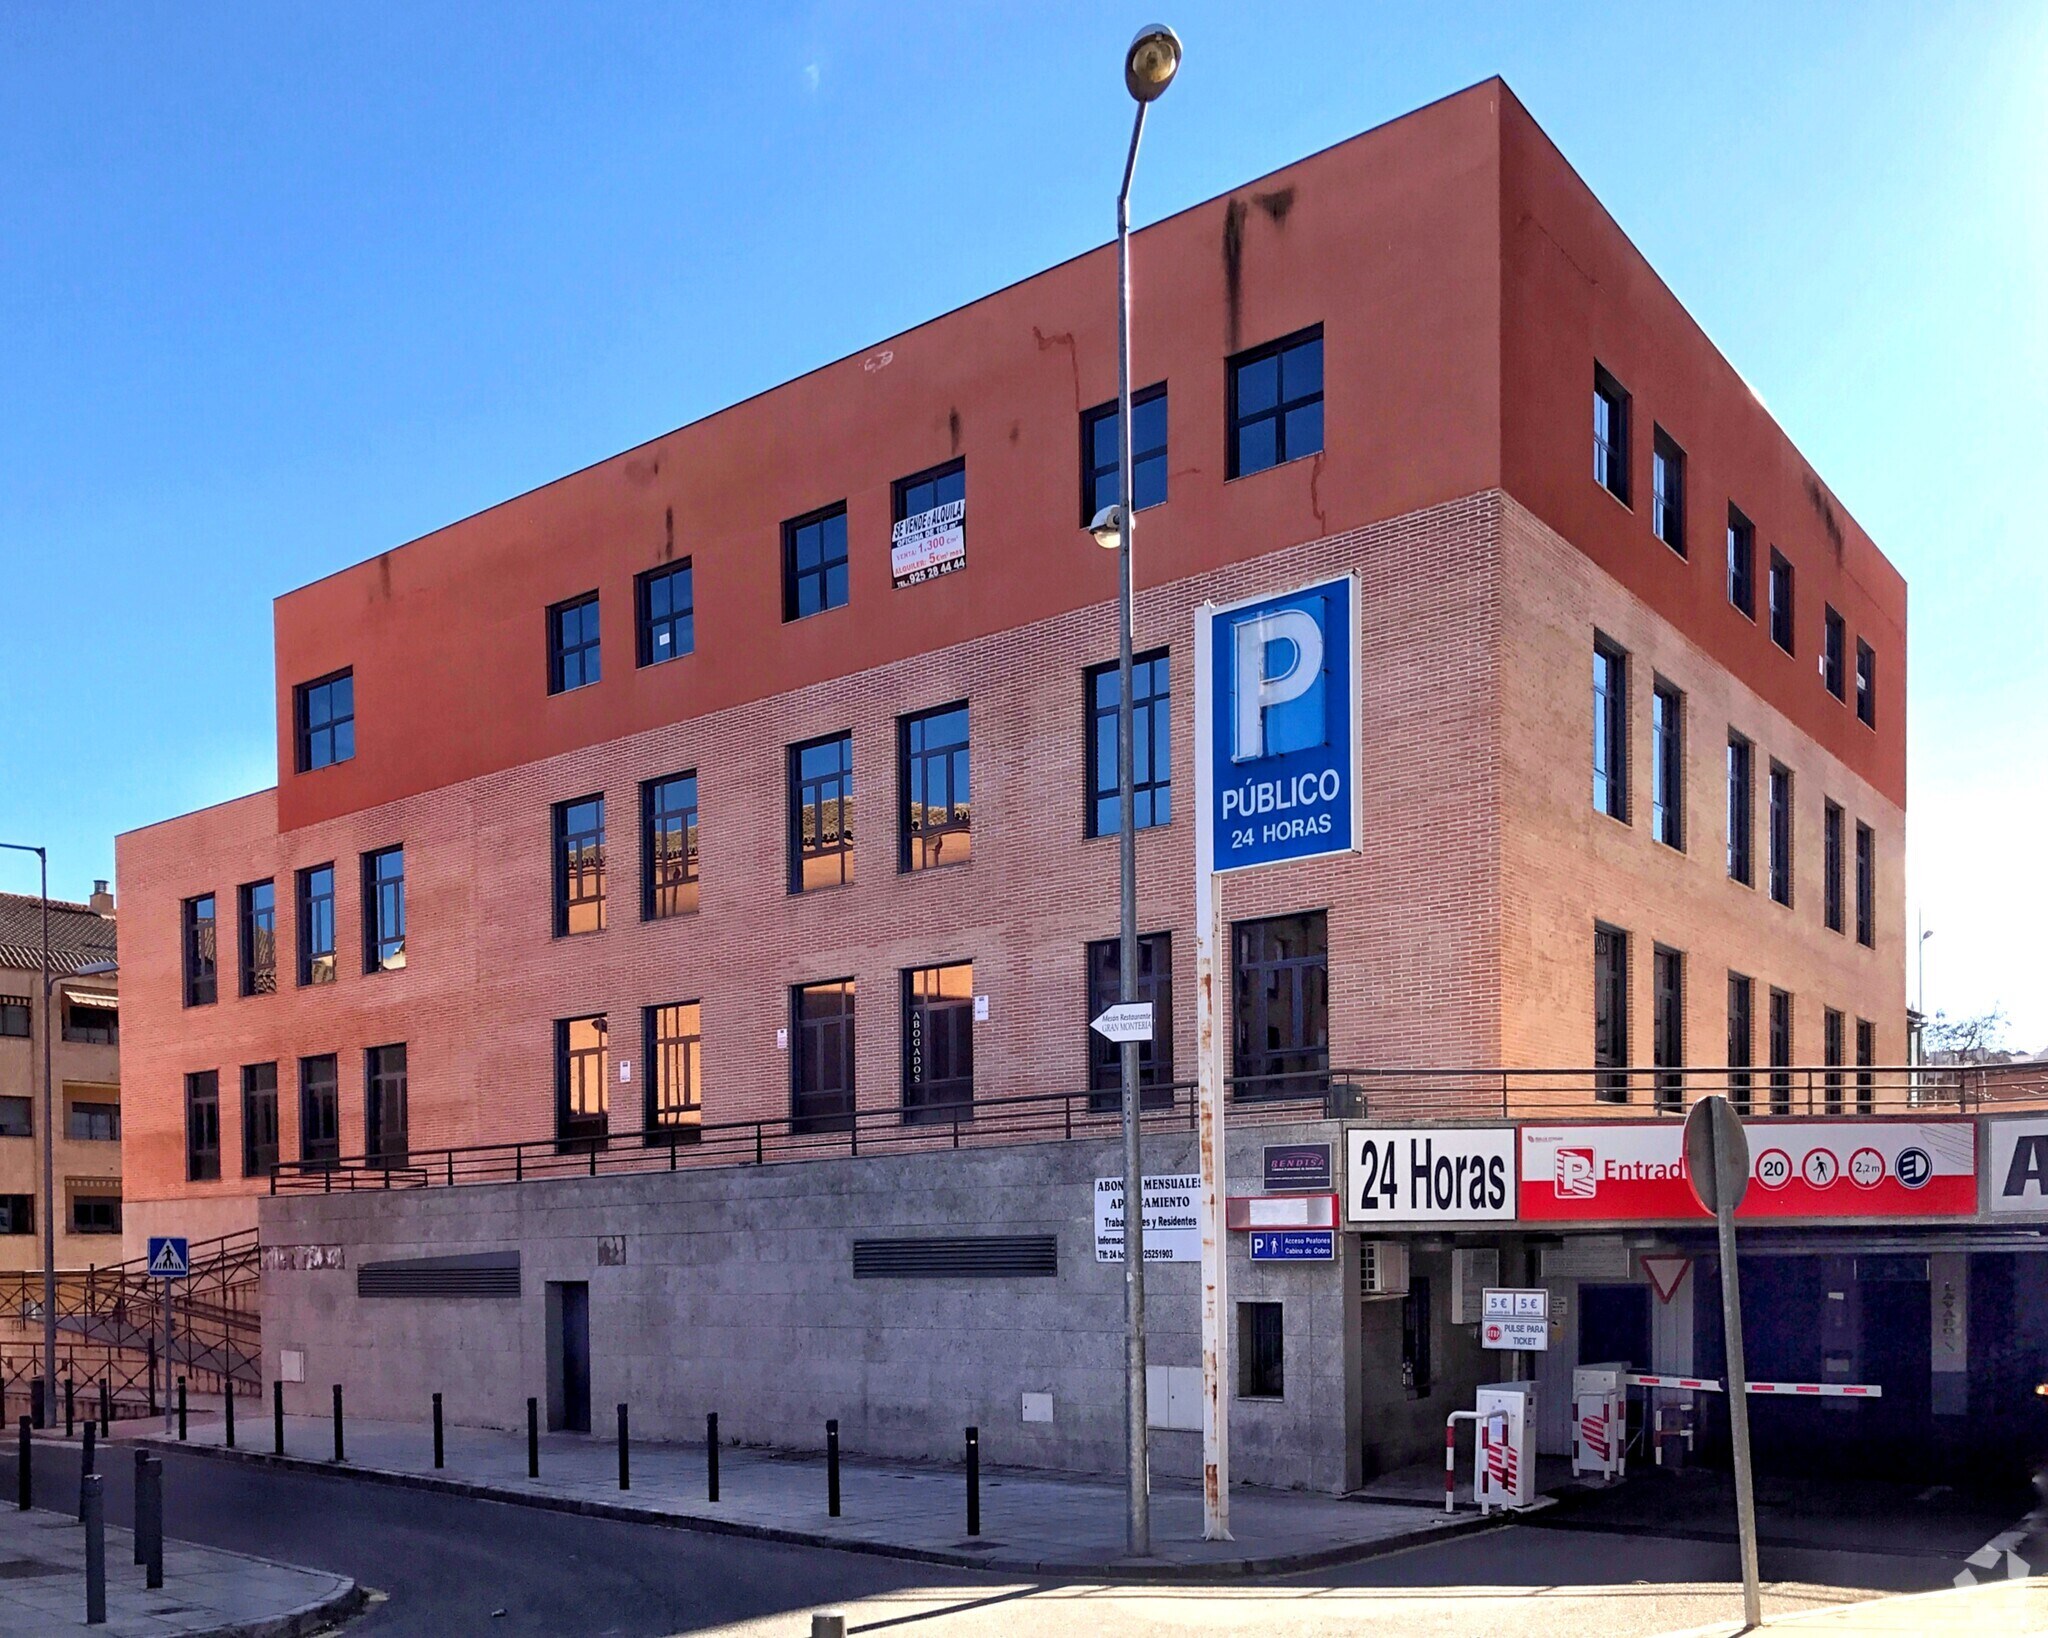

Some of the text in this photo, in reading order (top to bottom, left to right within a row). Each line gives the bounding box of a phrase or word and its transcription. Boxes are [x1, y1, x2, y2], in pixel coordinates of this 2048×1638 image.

[895, 522, 904, 539] SE
[905, 513, 927, 535] VENDE
[931, 501, 962, 525] ALQUILA
[896, 532, 924, 546] OFICINA
[925, 529, 934, 538] DE
[918, 536, 945, 553] 1.300
[929, 552, 936, 564] 5
[909, 569, 926, 584] 925
[927, 566, 939, 578] 28
[940, 561, 952, 574] 44
[953, 556, 966, 569] 44
[1233, 608, 1323, 763] P
[1222, 767, 1341, 820] PÚBLICO
[1231, 812, 1333, 849] 24 HORAS
[912, 1011, 921, 1083] ABOGADOS
[1360, 1137, 1506, 1211] 24 Horas
[1603, 1157, 1684, 1180] Entrad
[1763, 1161, 1784, 1177] 20
[1152, 1219, 1157, 1230] y
[1158, 1215, 1197, 1227] Residentes
[1254, 1238, 1264, 1254] P
[1313, 1246, 1331, 1254] Cobro
[1491, 1298, 1507, 1308] 5 €
[1521, 1299, 1537, 1308] 5 €
[1487, 1330, 1499, 1338] STOP
[1504, 1324, 1544, 1333] PULSE PARA
[1513, 1337, 1537, 1345] TICKET
